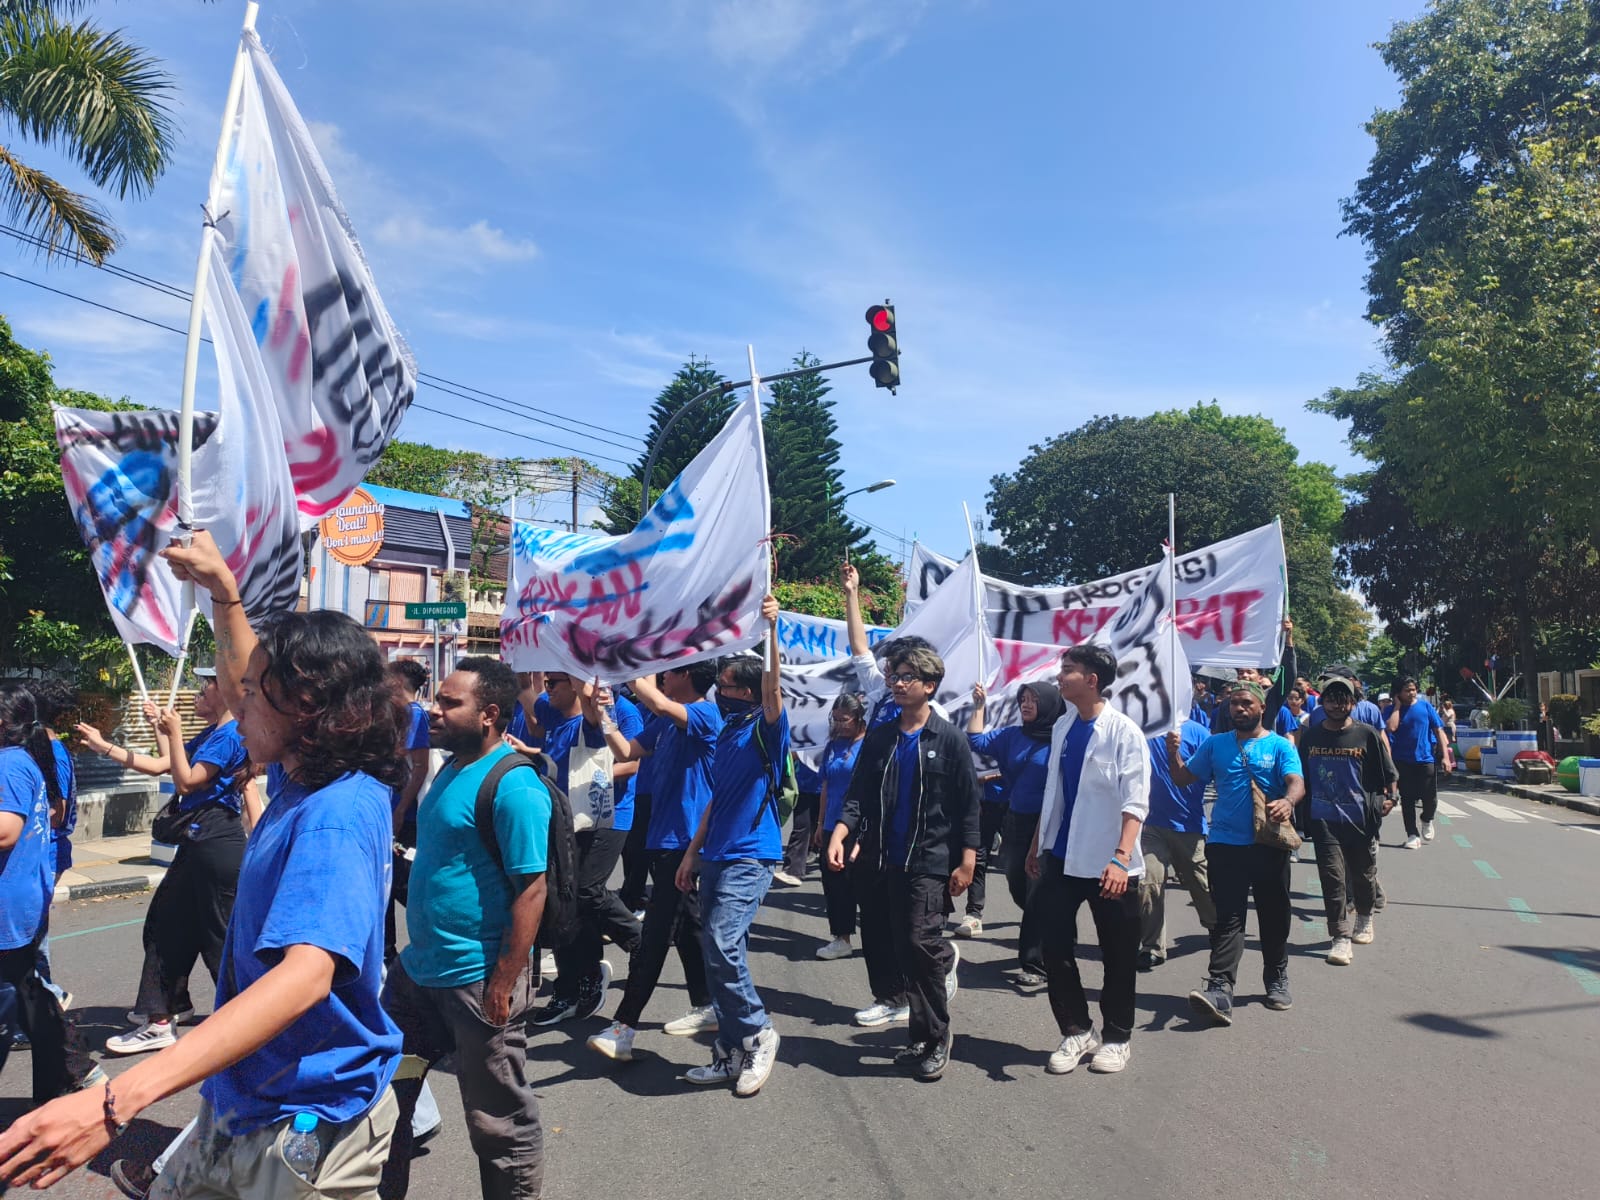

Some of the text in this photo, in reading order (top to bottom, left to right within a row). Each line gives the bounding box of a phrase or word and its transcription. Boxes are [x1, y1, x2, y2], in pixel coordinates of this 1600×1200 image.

[337, 516, 367, 532] Deal!!
[326, 535, 349, 548] Don't
[351, 534, 371, 545] miss
[422, 606, 458, 615] DIPONEGORO
[1052, 589, 1265, 646] KERAT
[777, 615, 837, 657] KAMI
[1307, 745, 1365, 759] MEGADETH
